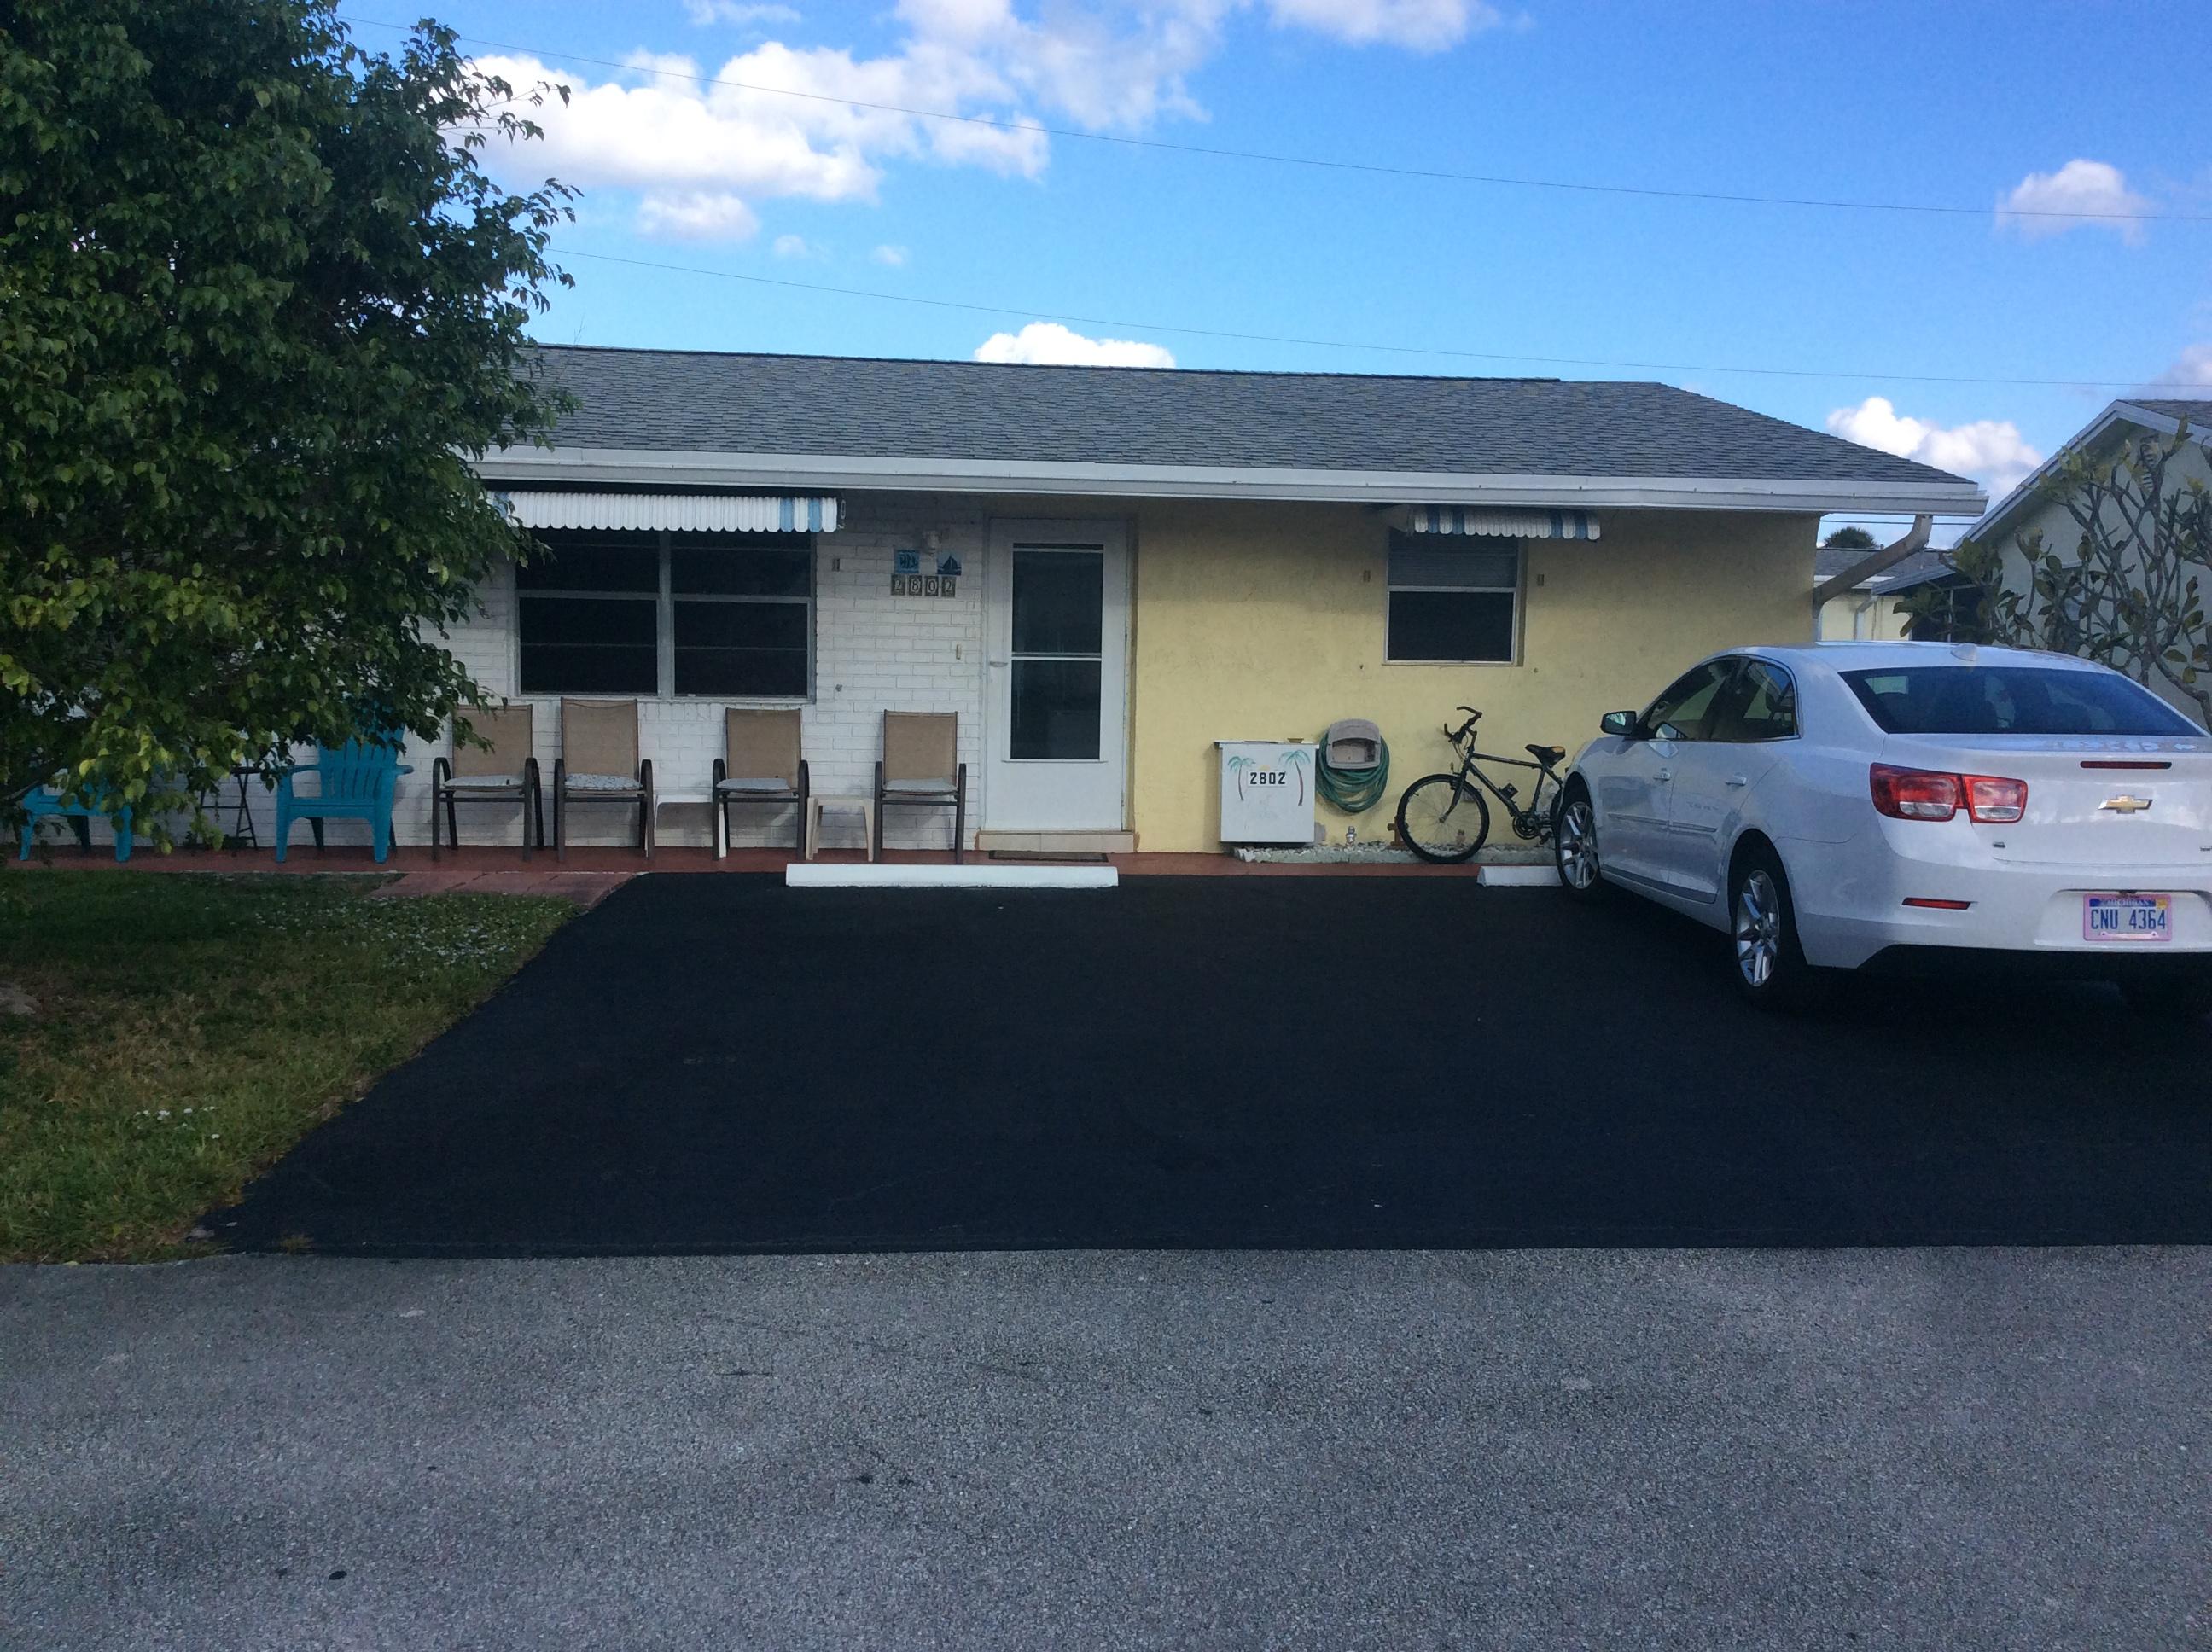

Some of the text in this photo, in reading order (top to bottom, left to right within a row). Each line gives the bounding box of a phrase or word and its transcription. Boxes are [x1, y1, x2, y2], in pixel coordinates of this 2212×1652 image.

[893, 578, 954, 594] 2802
[1249, 771, 1286, 785] 2802
[2091, 909, 2165, 929] CNU 4364
